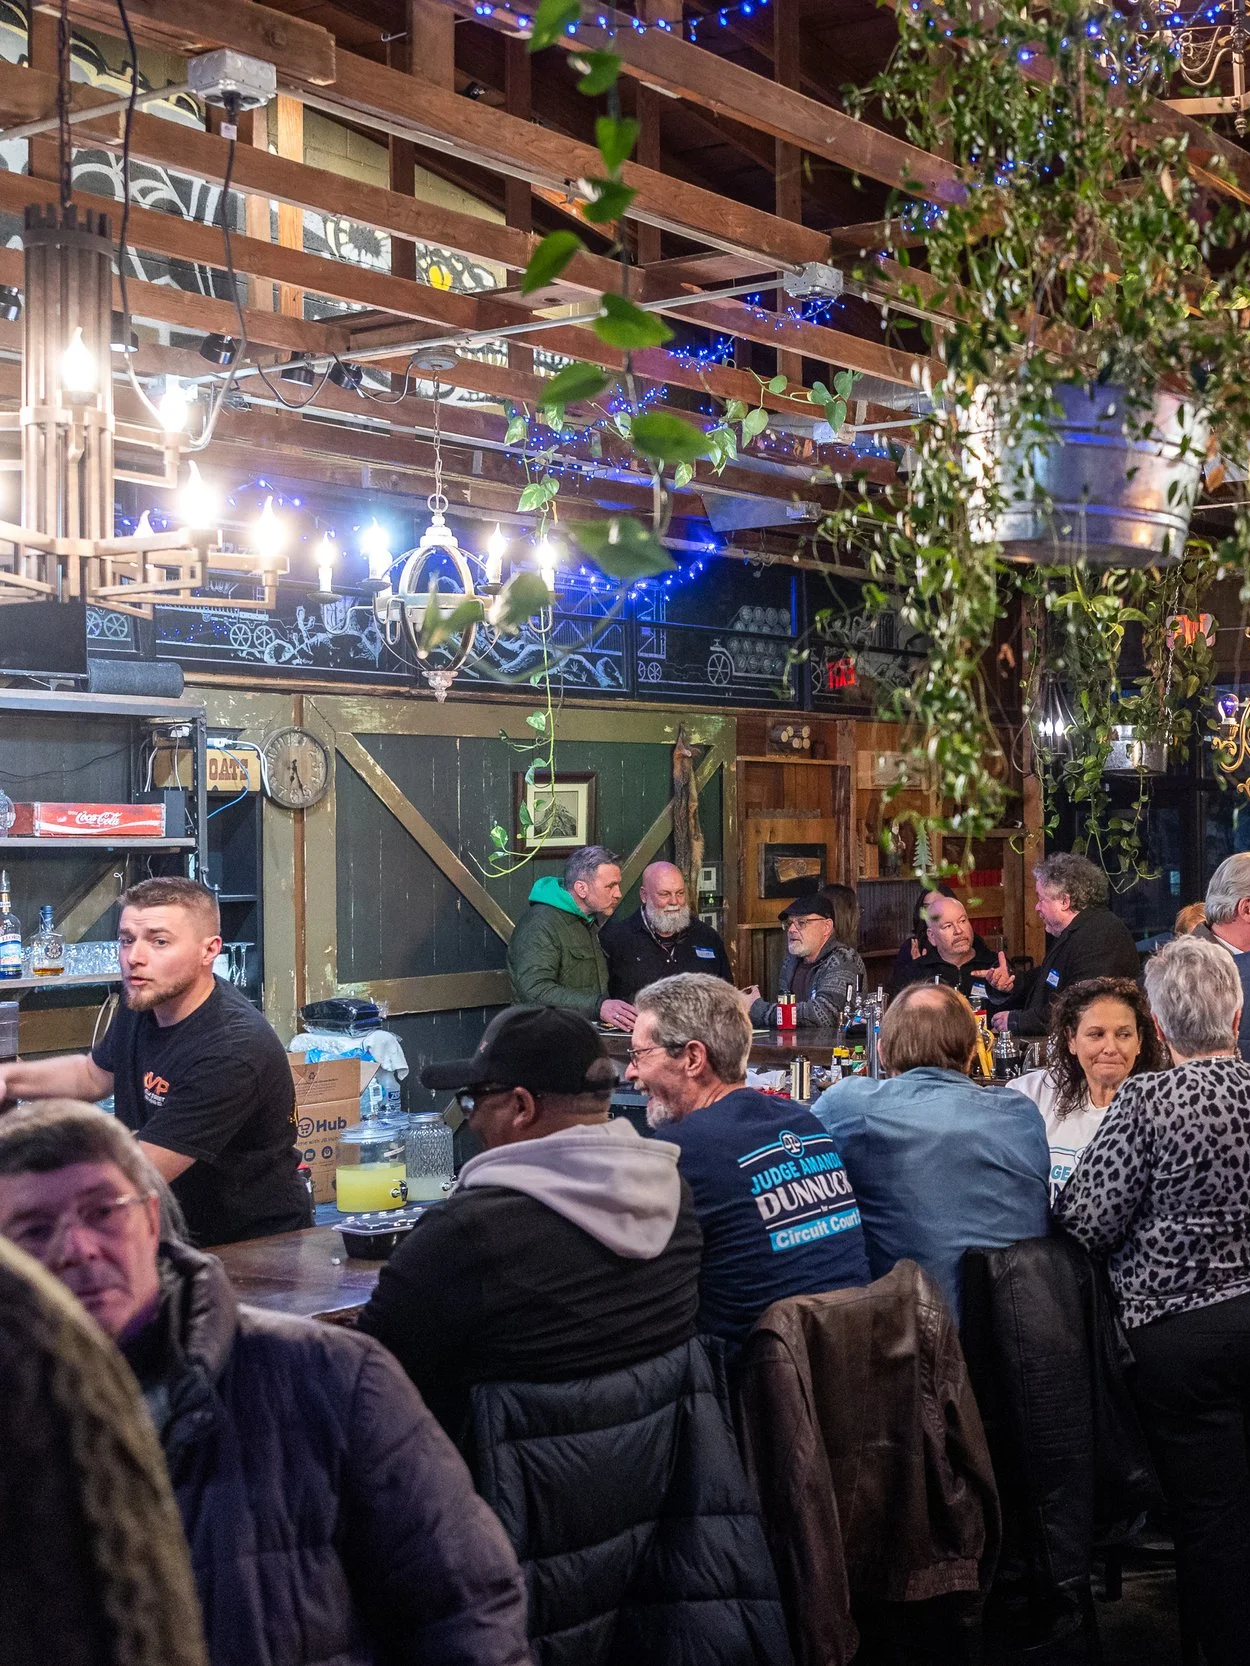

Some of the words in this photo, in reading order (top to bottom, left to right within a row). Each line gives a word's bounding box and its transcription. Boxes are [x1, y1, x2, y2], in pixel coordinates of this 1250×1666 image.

[75, 810, 122, 826] Coca-Cola
[316, 1116, 347, 1132] Hub
[751, 1162, 800, 1194] JUDGE
[775, 1220, 830, 1248] Circuit
[830, 1211, 858, 1231] Court
